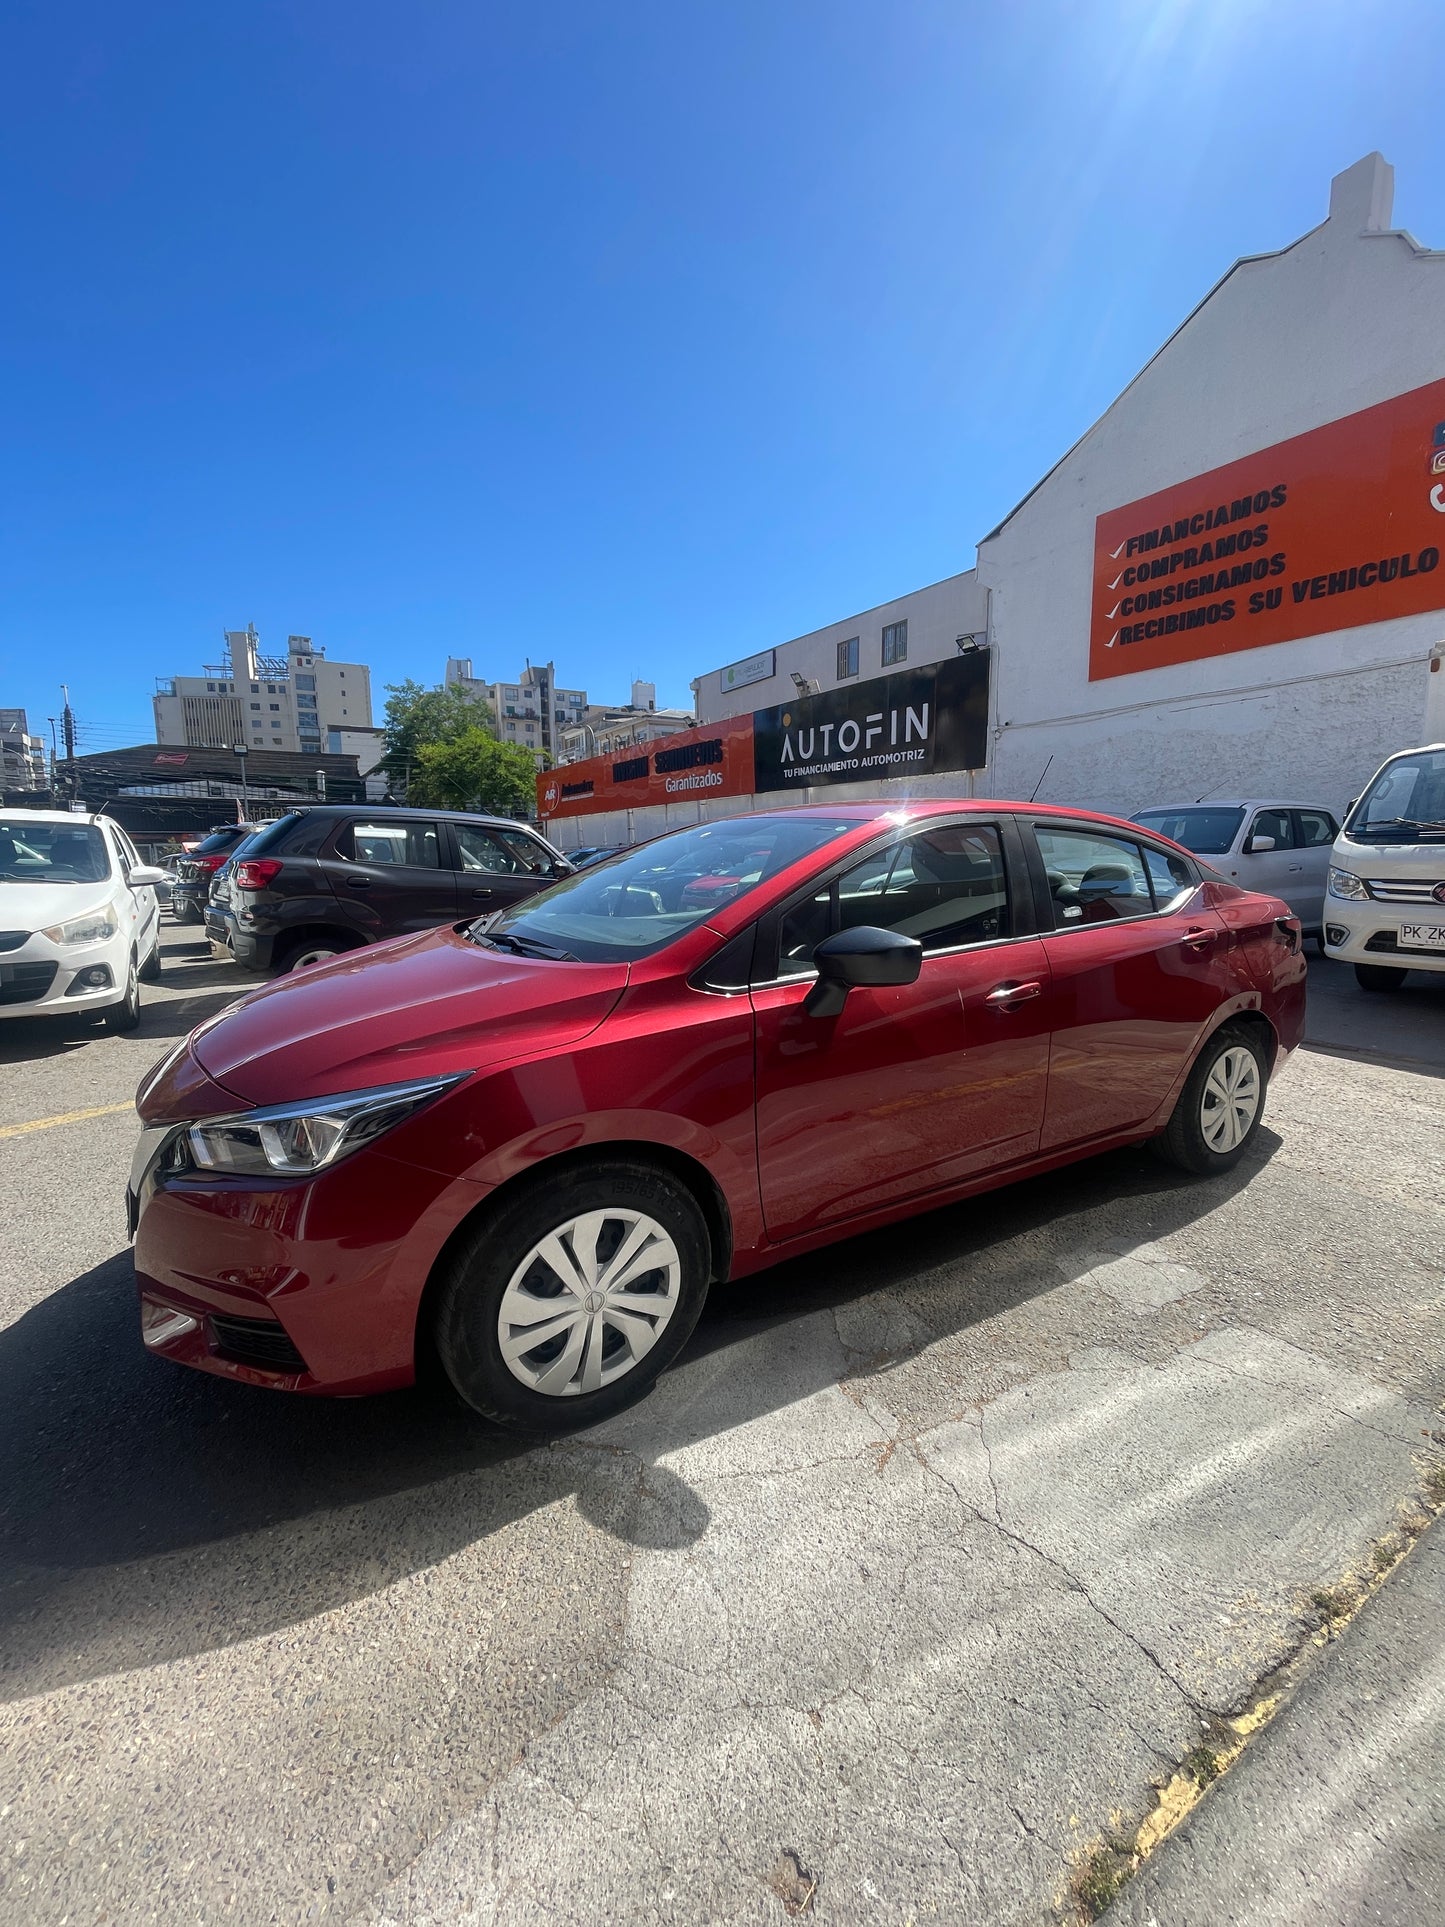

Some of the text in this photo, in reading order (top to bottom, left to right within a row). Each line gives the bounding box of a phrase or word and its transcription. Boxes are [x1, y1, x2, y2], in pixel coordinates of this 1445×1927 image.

[1126, 484, 1287, 558] FINANCIAMOS
[1121, 553, 1286, 617] CONSIGNAMOS
[1123, 524, 1269, 587] COMPRAMOS
[1119, 547, 1440, 645] RECIBIMOS SU VEHICULO
[780, 703, 929, 763] AUTOFIN
[665, 769, 723, 792] Garantizados
[783, 749, 925, 779] TU FINANCIAMIENTO AUTOMOTRIZ
[1403, 926, 1422, 939] PK
